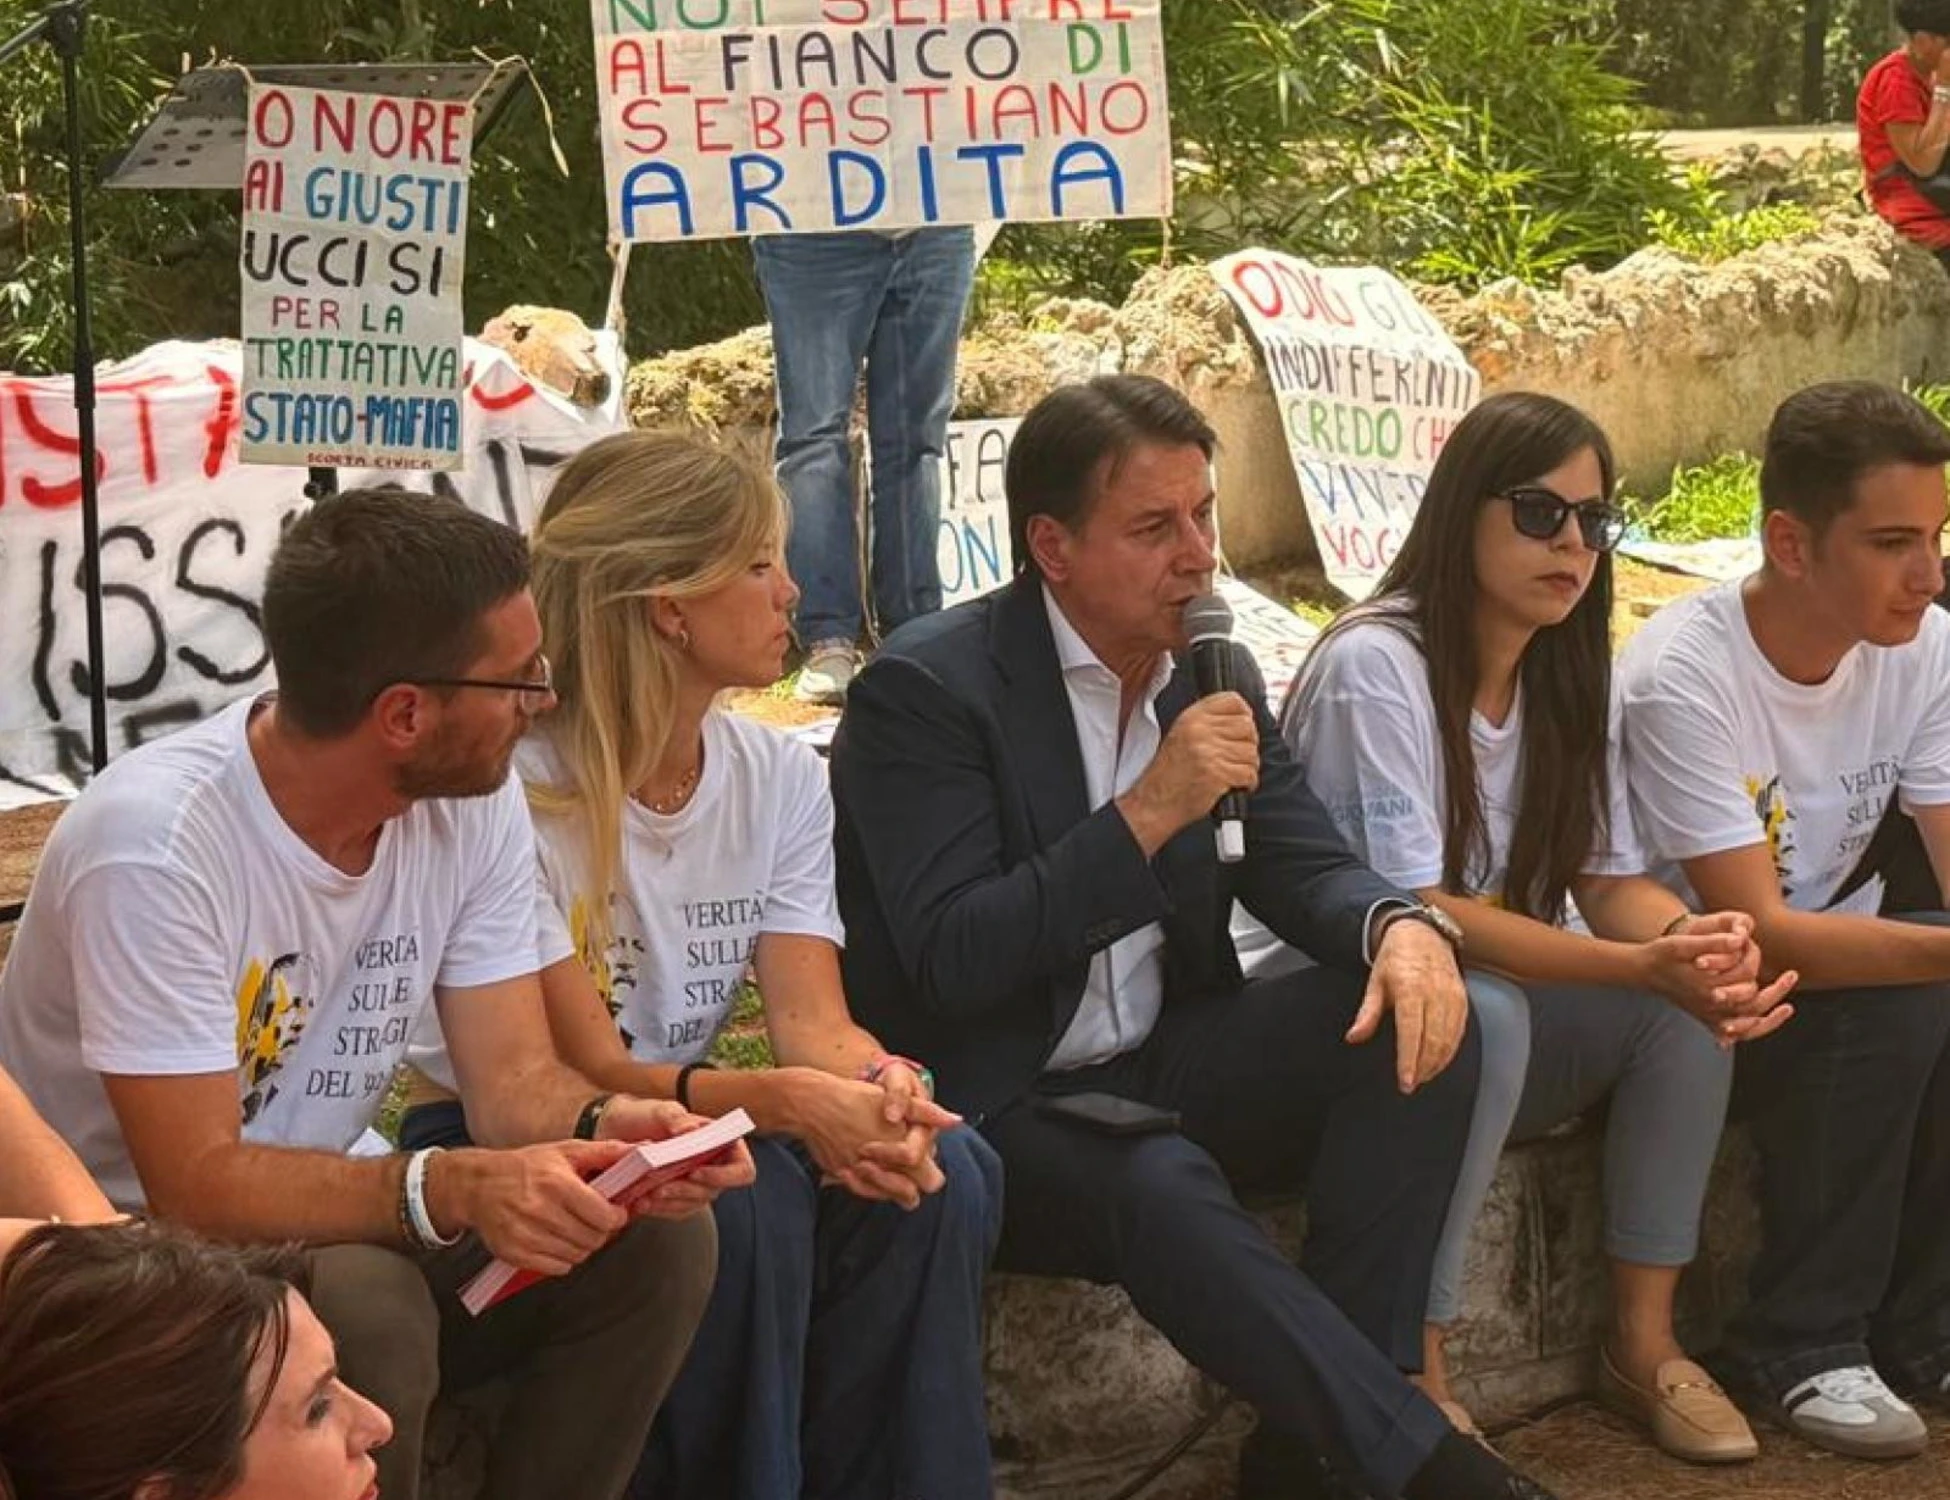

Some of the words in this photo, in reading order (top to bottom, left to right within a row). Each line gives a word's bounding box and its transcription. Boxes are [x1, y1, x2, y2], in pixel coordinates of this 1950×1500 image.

[611, 39, 690, 95] AL
[720, 28, 1020, 92] FIANCO
[1066, 22, 1132, 75] DI
[620, 82, 1148, 154] SEBASTIANO
[243, 159, 283, 213] AI
[305, 166, 462, 234] GIUSTI
[620, 141, 1125, 238] ARDITA
[271, 296, 340, 330] PER
[361, 303, 404, 334] LA
[246, 337, 457, 389] TRATTATIVA
[243, 390, 458, 452] STATO-MAFIA
[1287, 398, 1403, 460] CREDO
[1412, 415, 1455, 460] CH
[684, 889, 764, 930] VERITÀ
[305, 1068, 357, 1098] DEL
